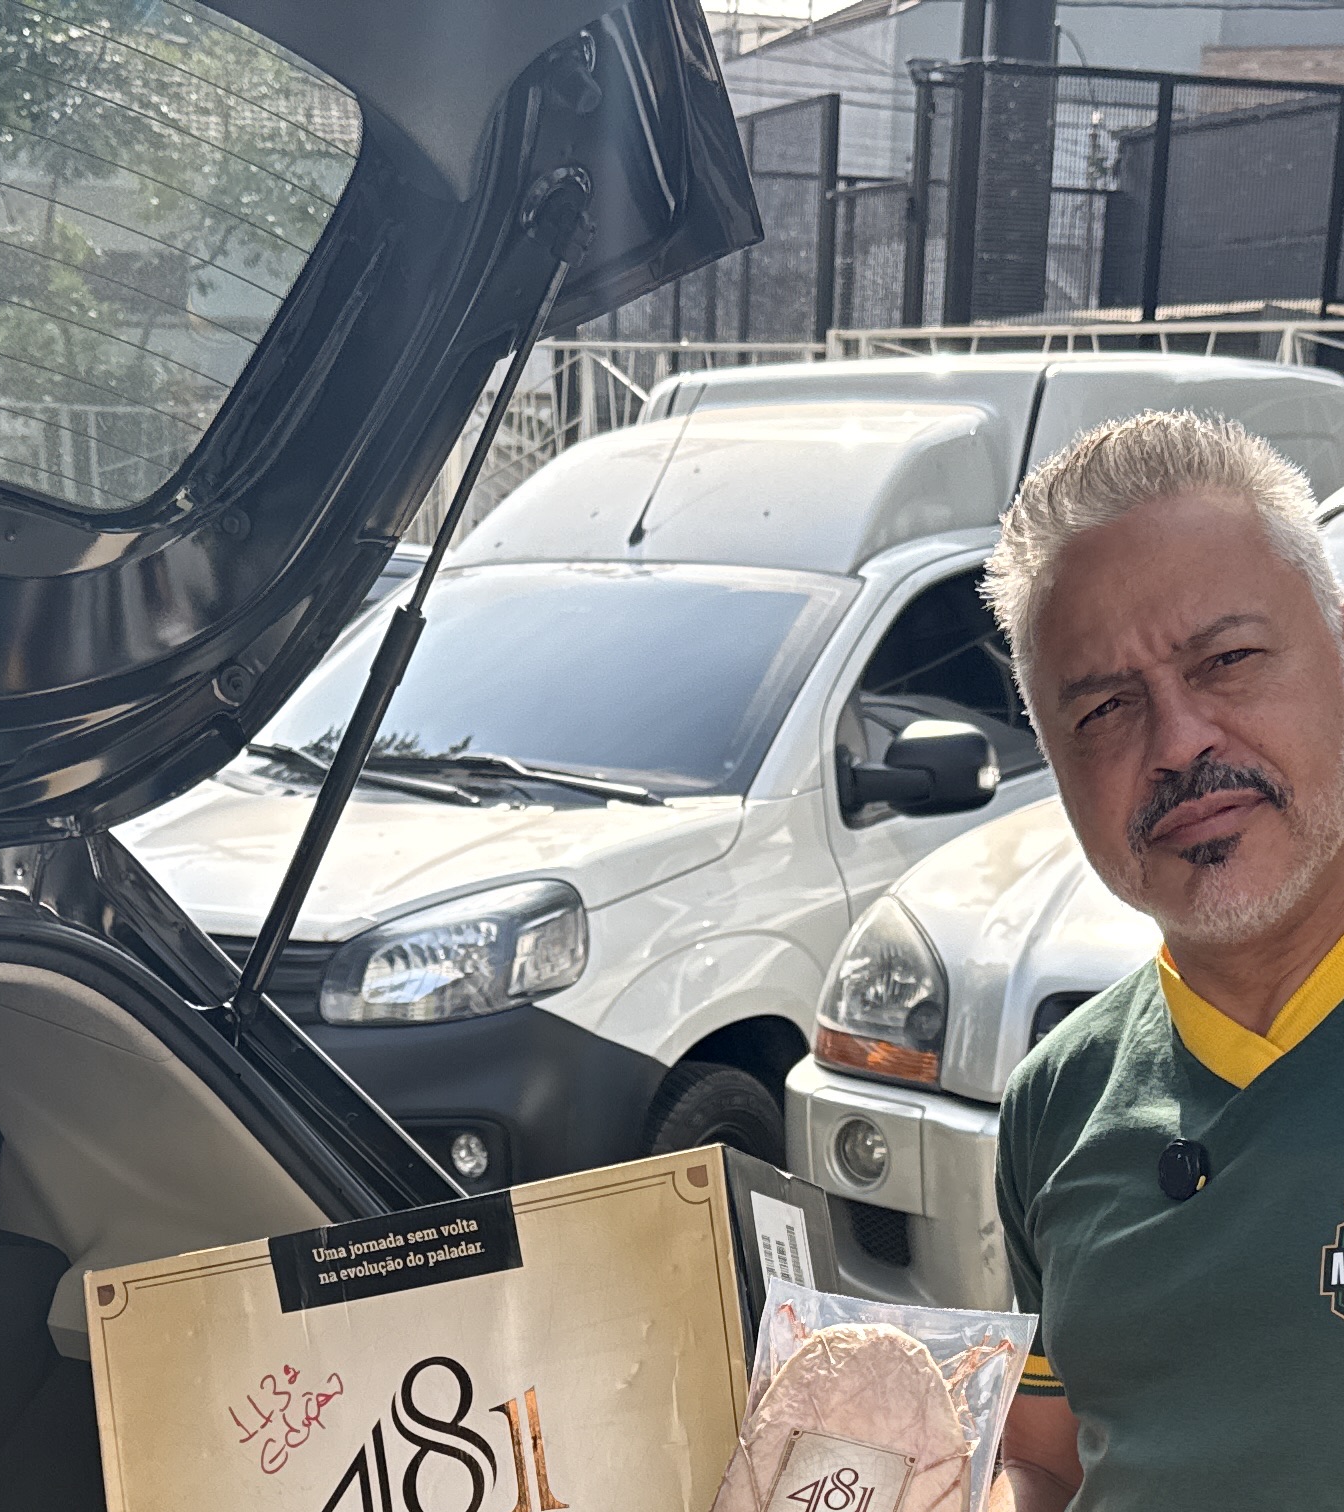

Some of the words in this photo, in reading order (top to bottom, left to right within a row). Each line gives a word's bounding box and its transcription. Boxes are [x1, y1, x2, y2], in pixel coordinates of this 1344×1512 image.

[312, 1246, 348, 1263] Uma
[348, 1232, 406, 1260] jornada
[406, 1228, 439, 1245] sem
[439, 1218, 479, 1237] volta
[318, 1269, 338, 1285] na
[340, 1255, 404, 1281] evolução
[406, 1251, 425, 1268] do
[427, 1240, 486, 1267] paladar.
